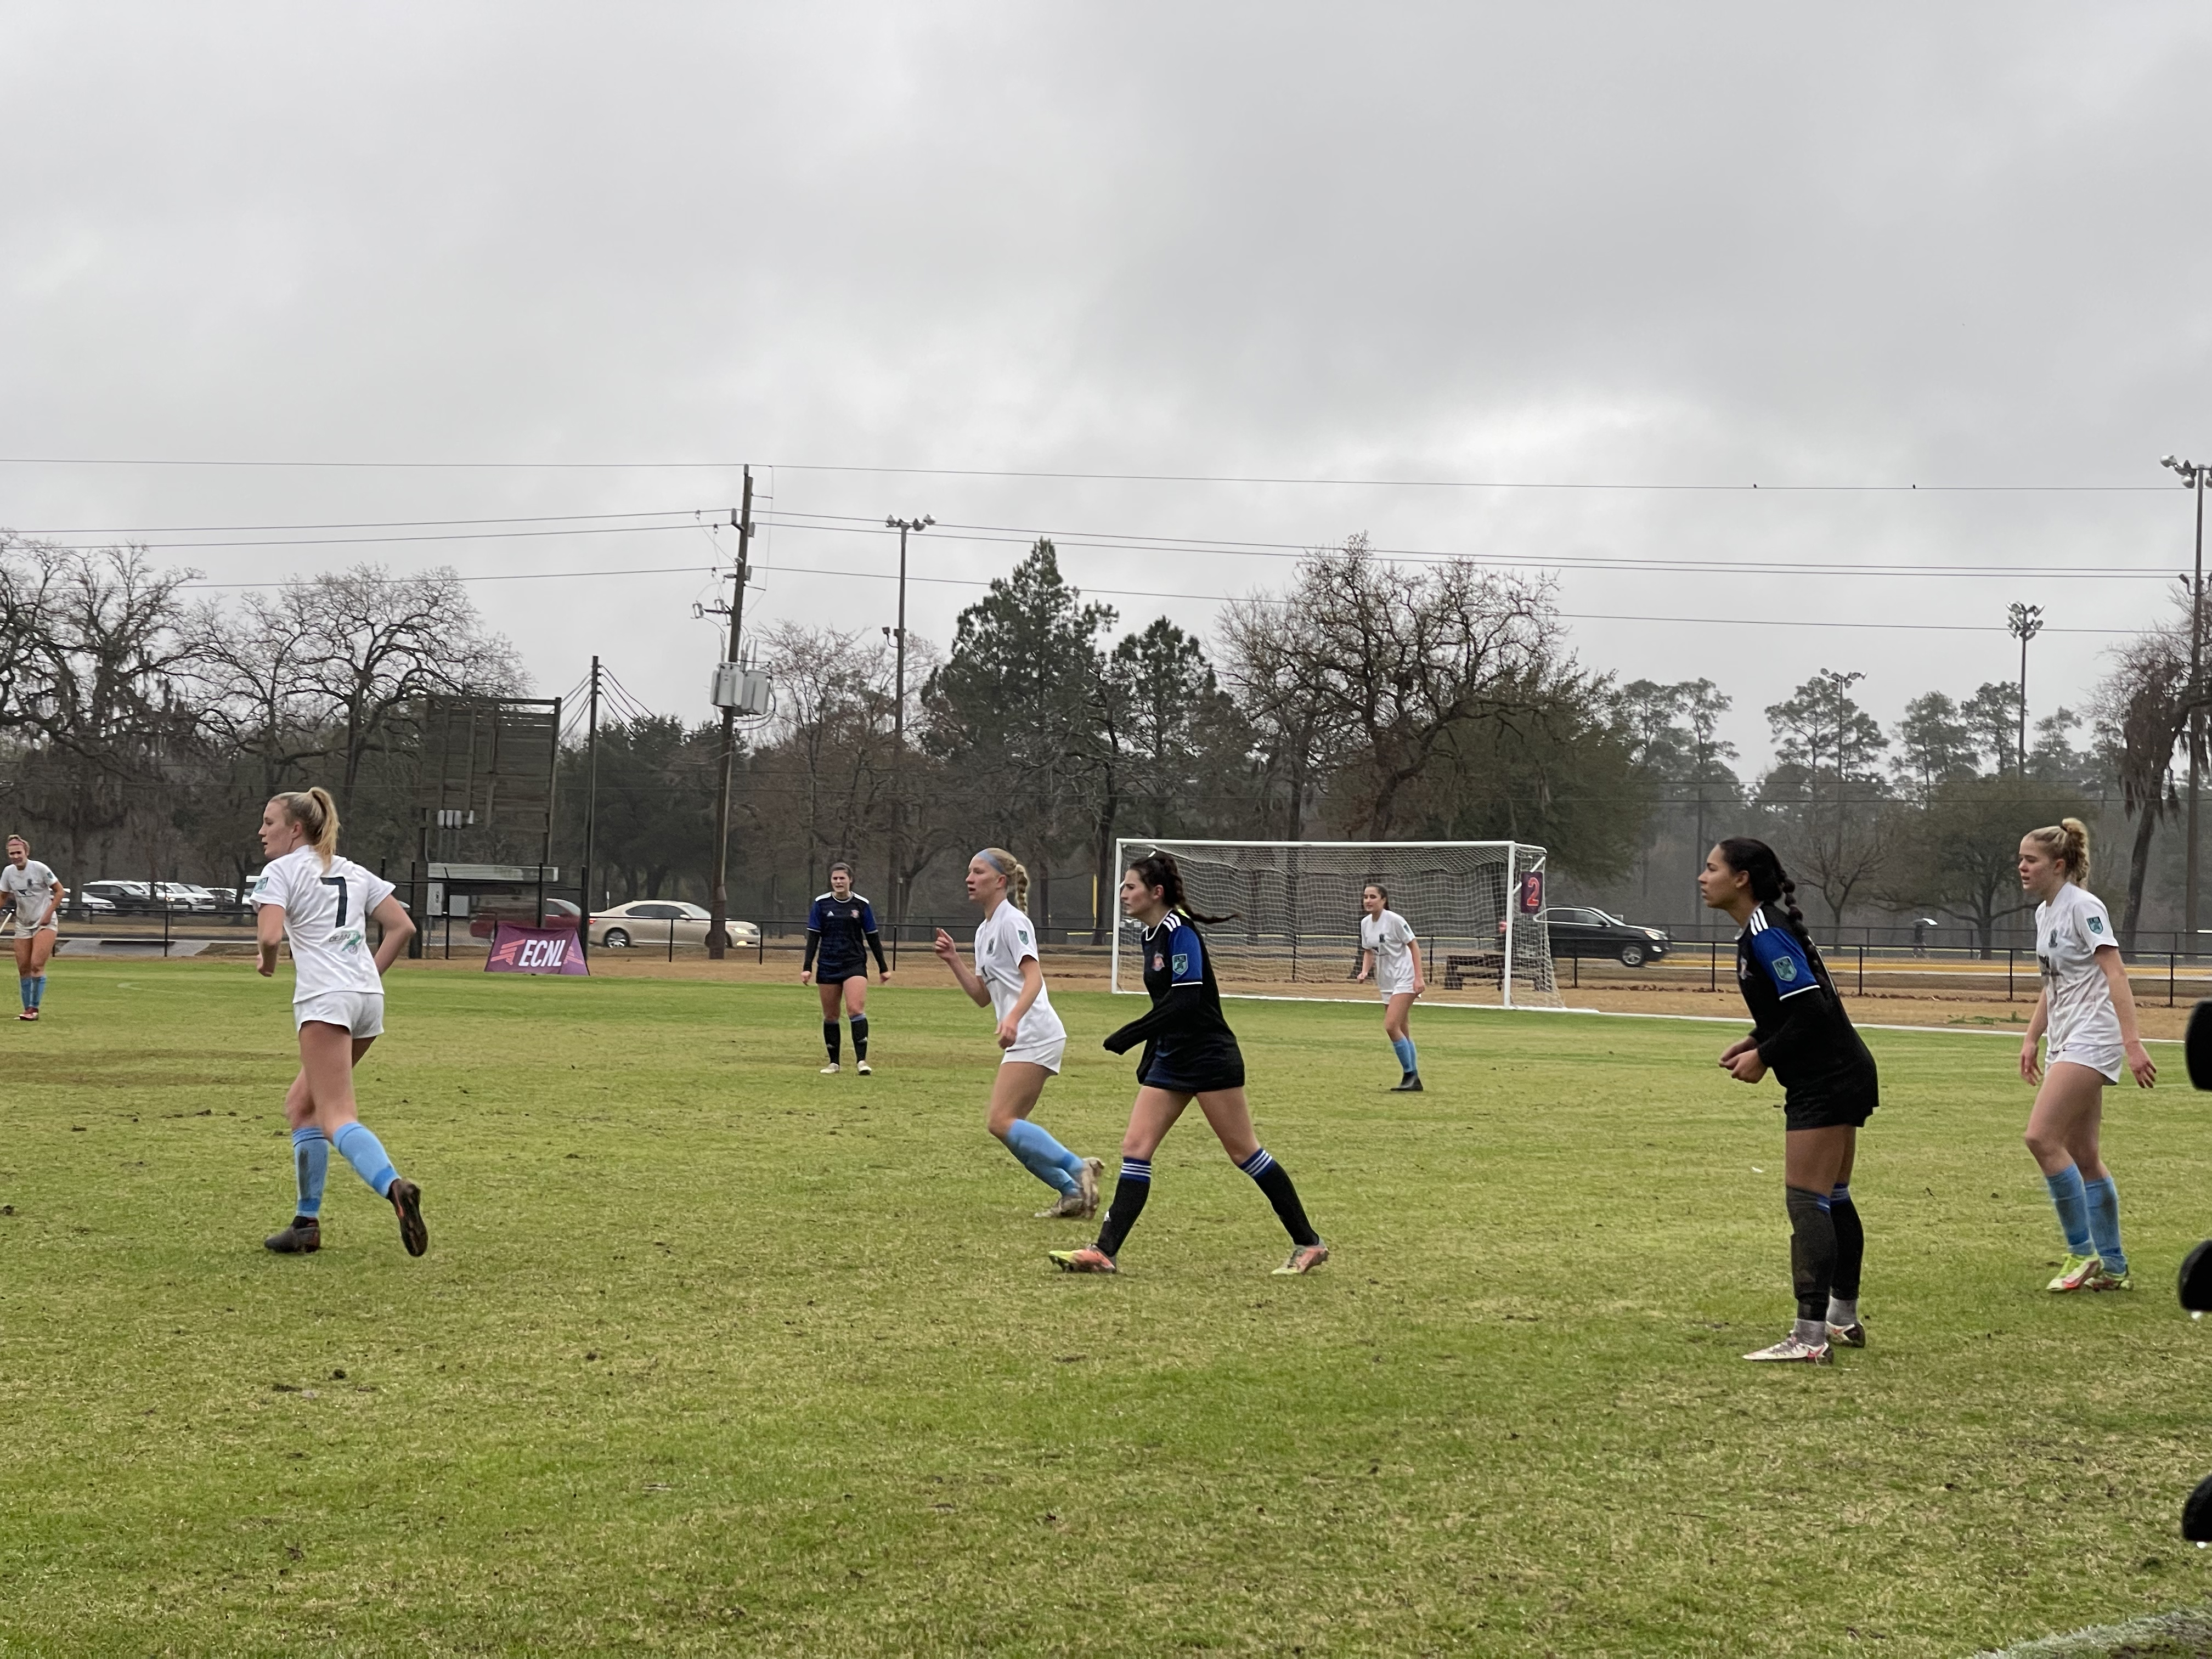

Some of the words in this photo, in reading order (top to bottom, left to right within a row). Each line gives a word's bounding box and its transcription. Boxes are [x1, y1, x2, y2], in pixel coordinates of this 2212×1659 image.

[320, 877, 348, 928] 7
[1527, 877, 1540, 906] 2
[518, 940, 566, 967] ECNL
